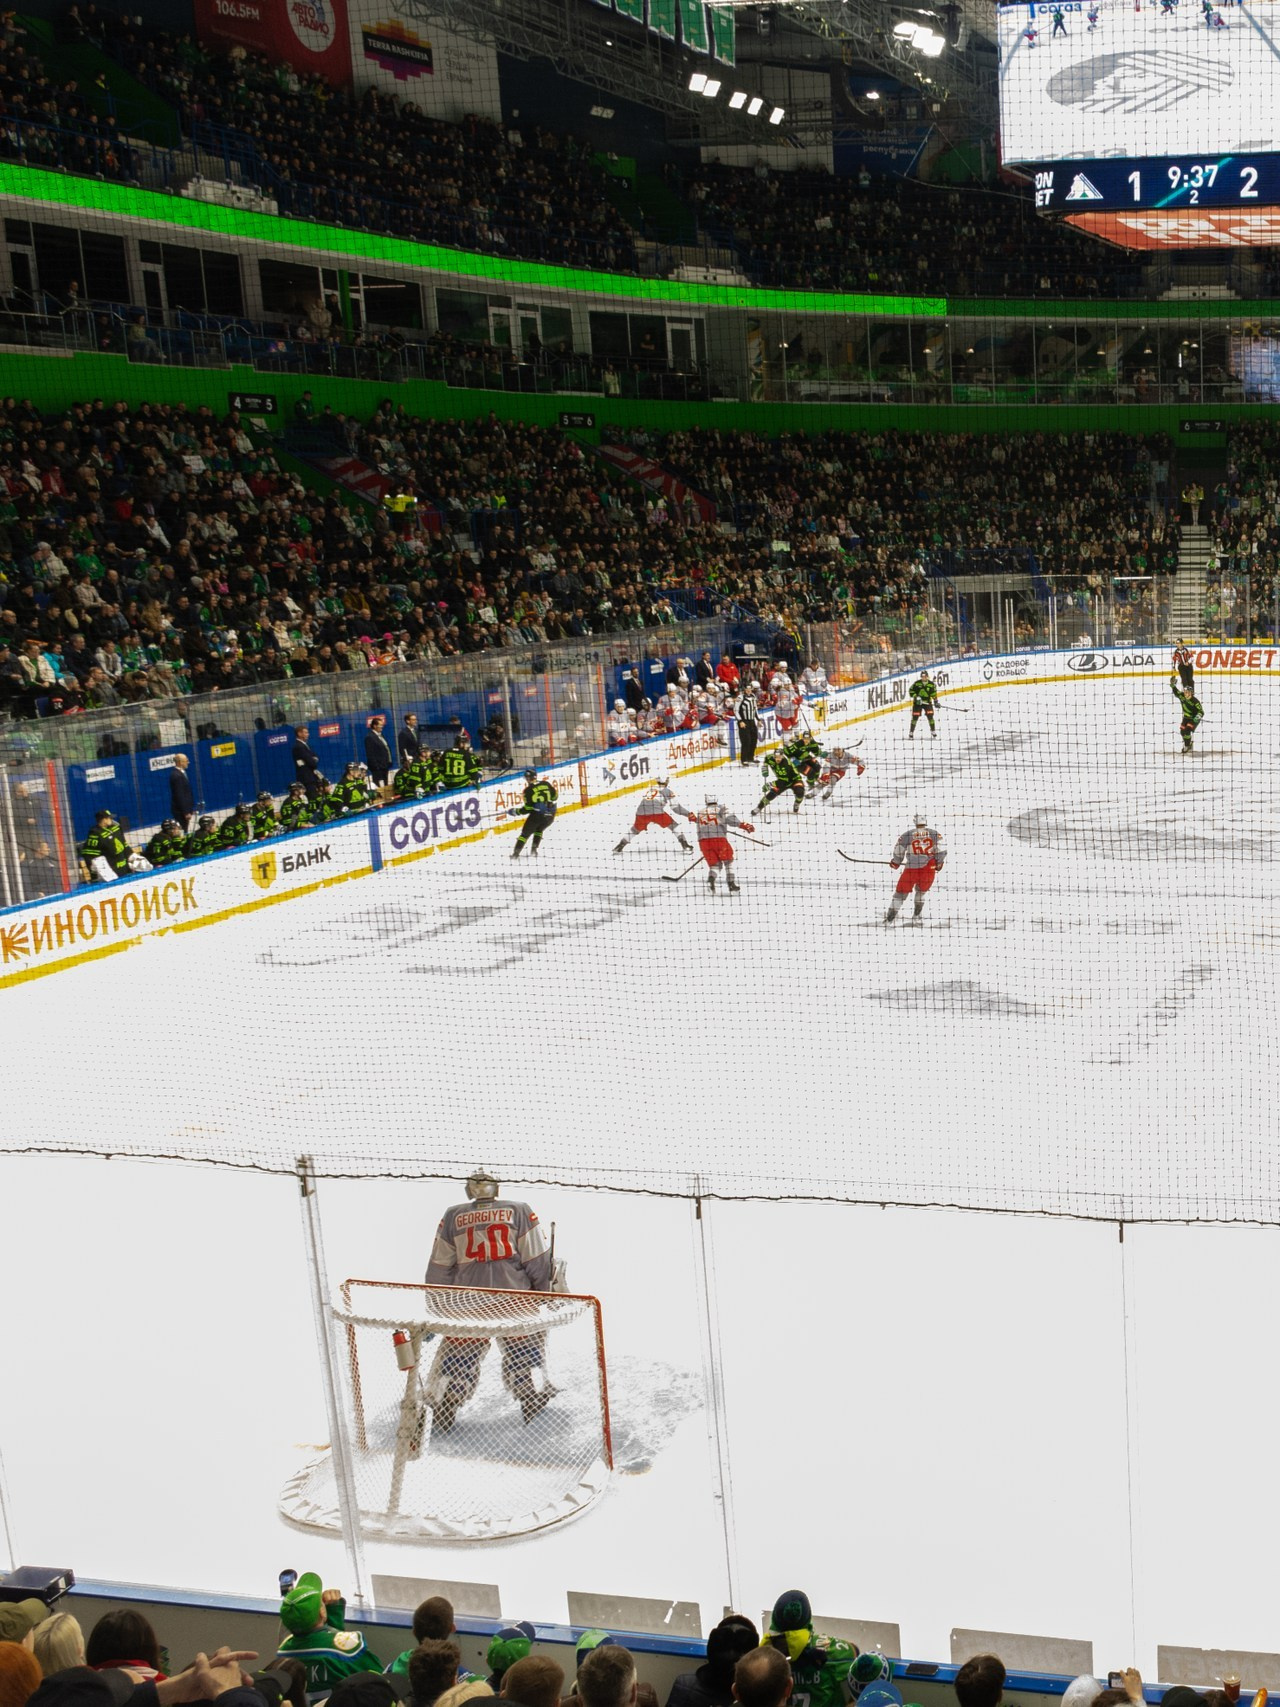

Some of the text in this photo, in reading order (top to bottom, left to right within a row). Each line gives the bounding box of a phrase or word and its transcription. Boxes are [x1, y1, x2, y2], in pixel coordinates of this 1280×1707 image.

[299, 14, 330, 35] РАДИО
[367, 38, 391, 52] TERRA
[1035, 171, 1054, 190] ON
[1128, 171, 1140, 201] 1
[1168, 165, 1218, 189] 9:37
[1240, 167, 1258, 198] 2
[1035, 188, 1055, 208] ET
[1190, 190, 1199, 204] 2
[234, 396, 241, 409] 4
[587, 417, 593, 426] 6
[1184, 422, 1190, 430] 6
[1215, 422, 1221, 430] 7
[996, 659, 1030, 669] САДОВОЕ
[1112, 654, 1155, 667] LADA
[867, 678, 907, 709] KHL.RU
[829, 700, 848, 714] БАНК
[668, 733, 718, 760] Альфа Ба
[444, 758, 466, 776] 18
[620, 753, 649, 780] сбп
[495, 788, 524, 811] Аль
[390, 797, 481, 850] согаз
[912, 837, 934, 856] 62
[282, 844, 332, 874] БАНК
[0, 877, 199, 963] КИНОПОИСК
[457, 1209, 513, 1228] GEORGIYEV
[465, 1223, 513, 1263] 40
